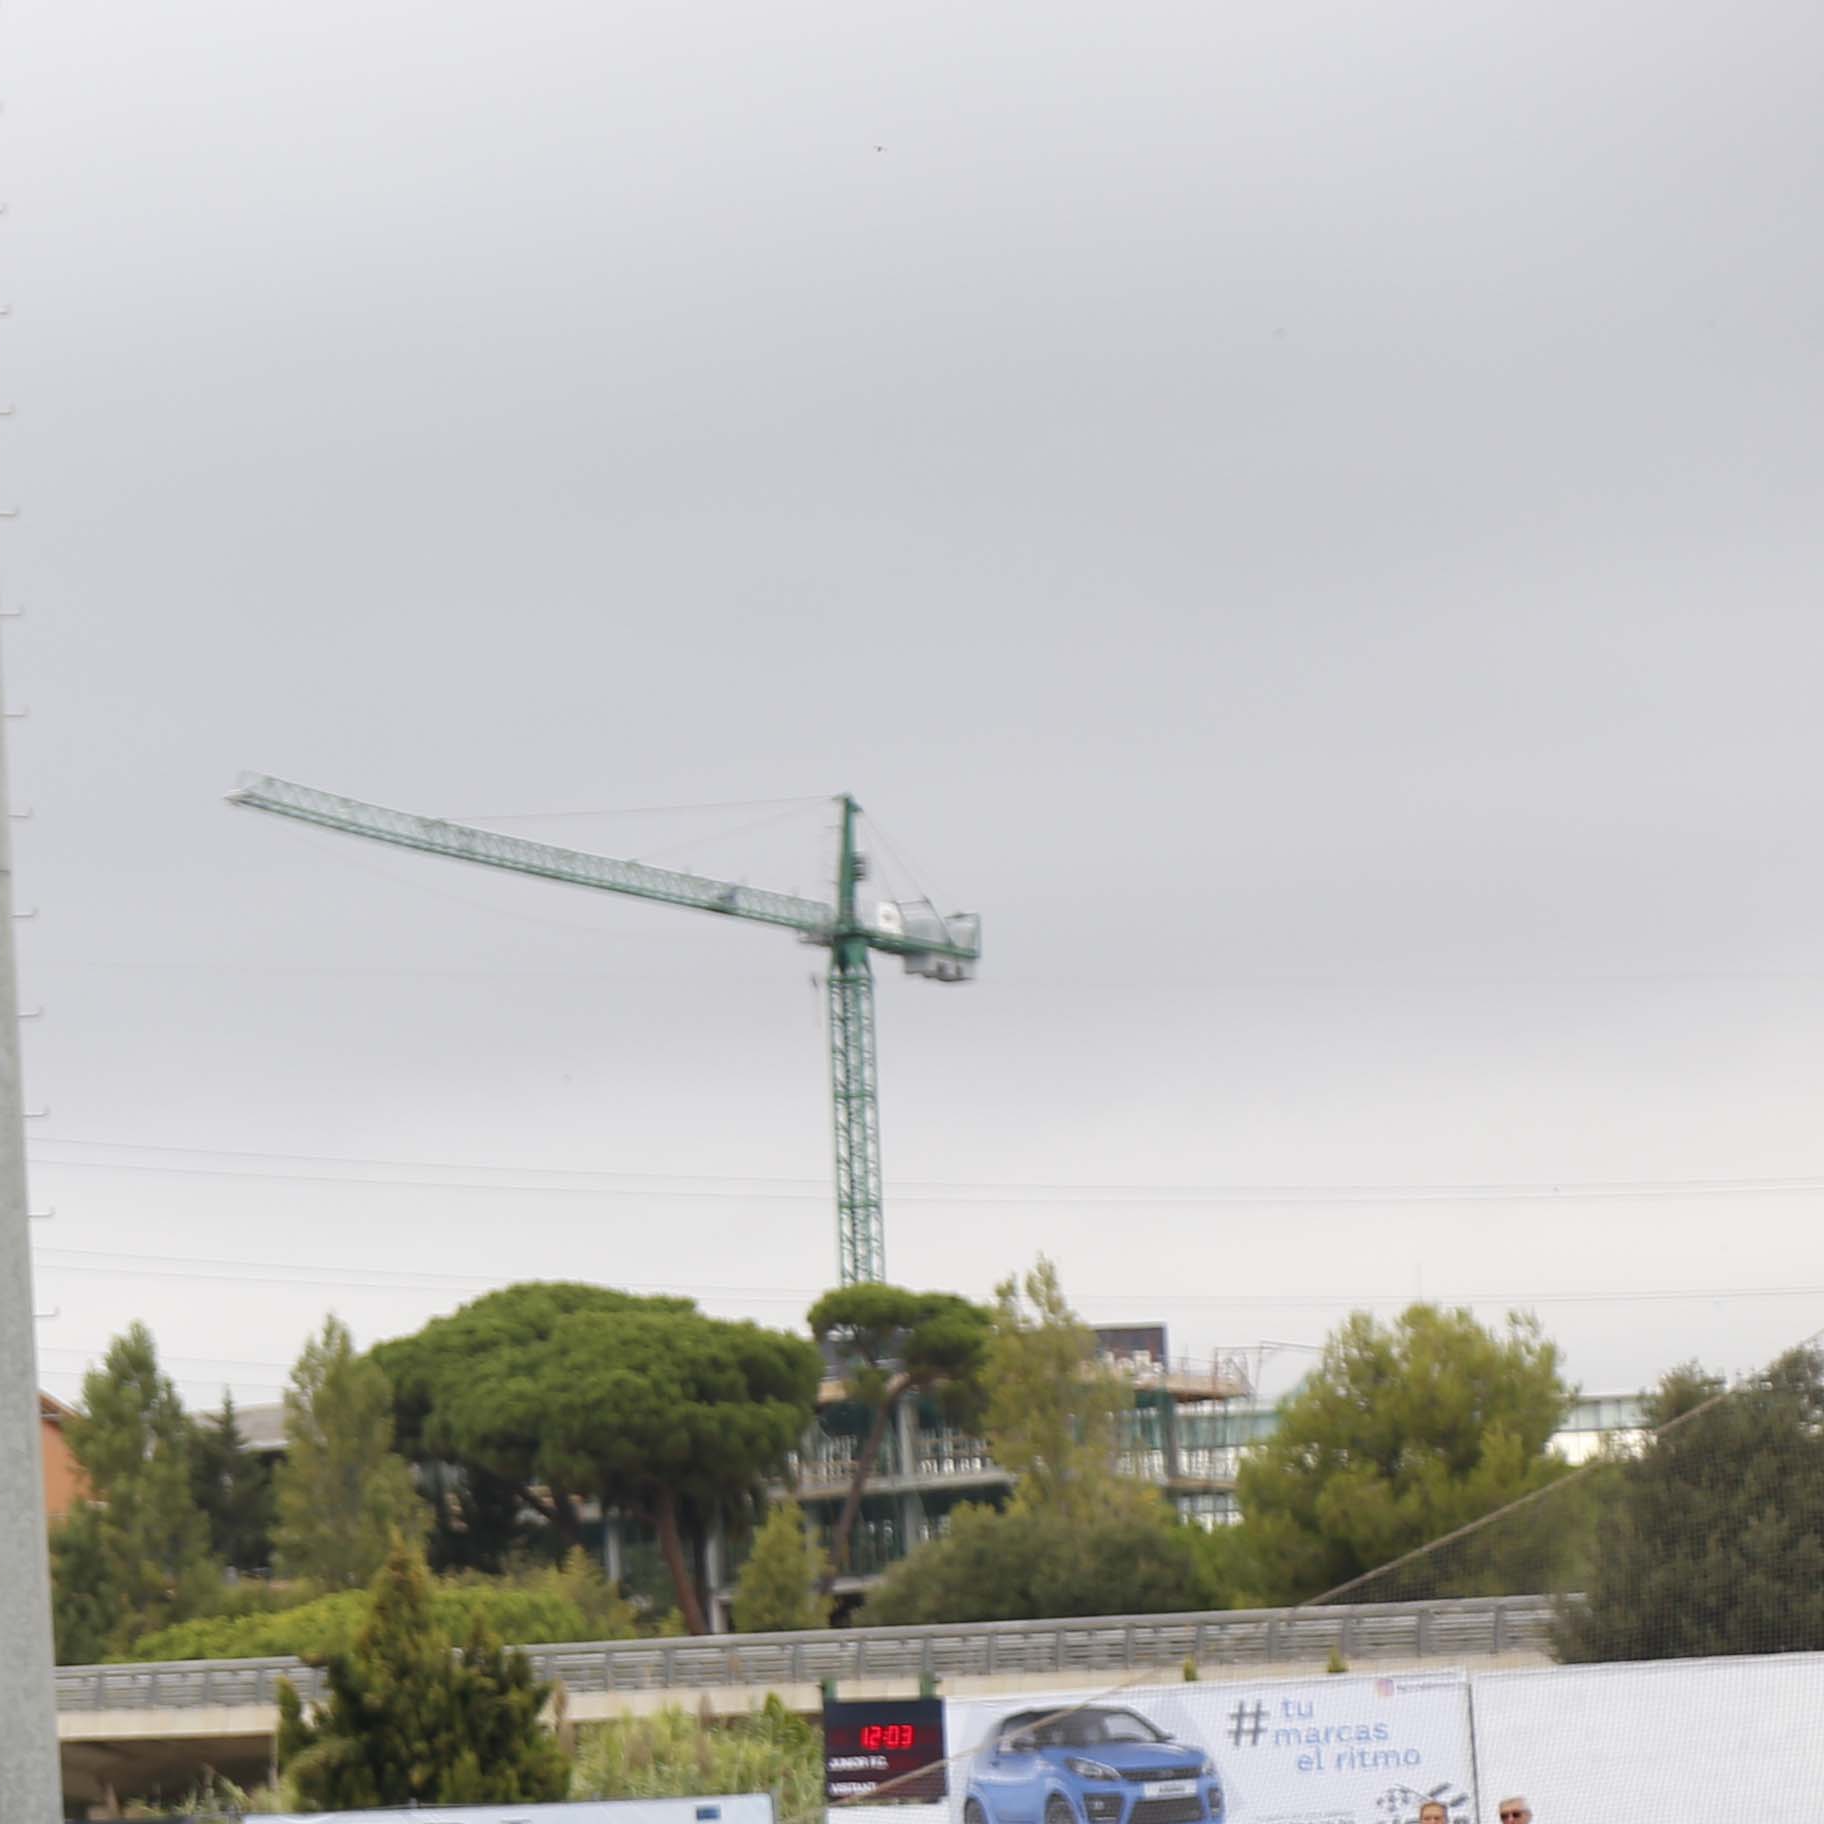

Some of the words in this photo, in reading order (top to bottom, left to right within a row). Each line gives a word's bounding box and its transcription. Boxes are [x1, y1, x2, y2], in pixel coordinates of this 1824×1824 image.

[1280, 1698, 1314, 1718] tu
[860, 1724, 915, 1750] 12:03
[1274, 1722, 1389, 1745] marcas
[1297, 1747, 1324, 1771] el
[1335, 1746, 1422, 1770] ritmo
